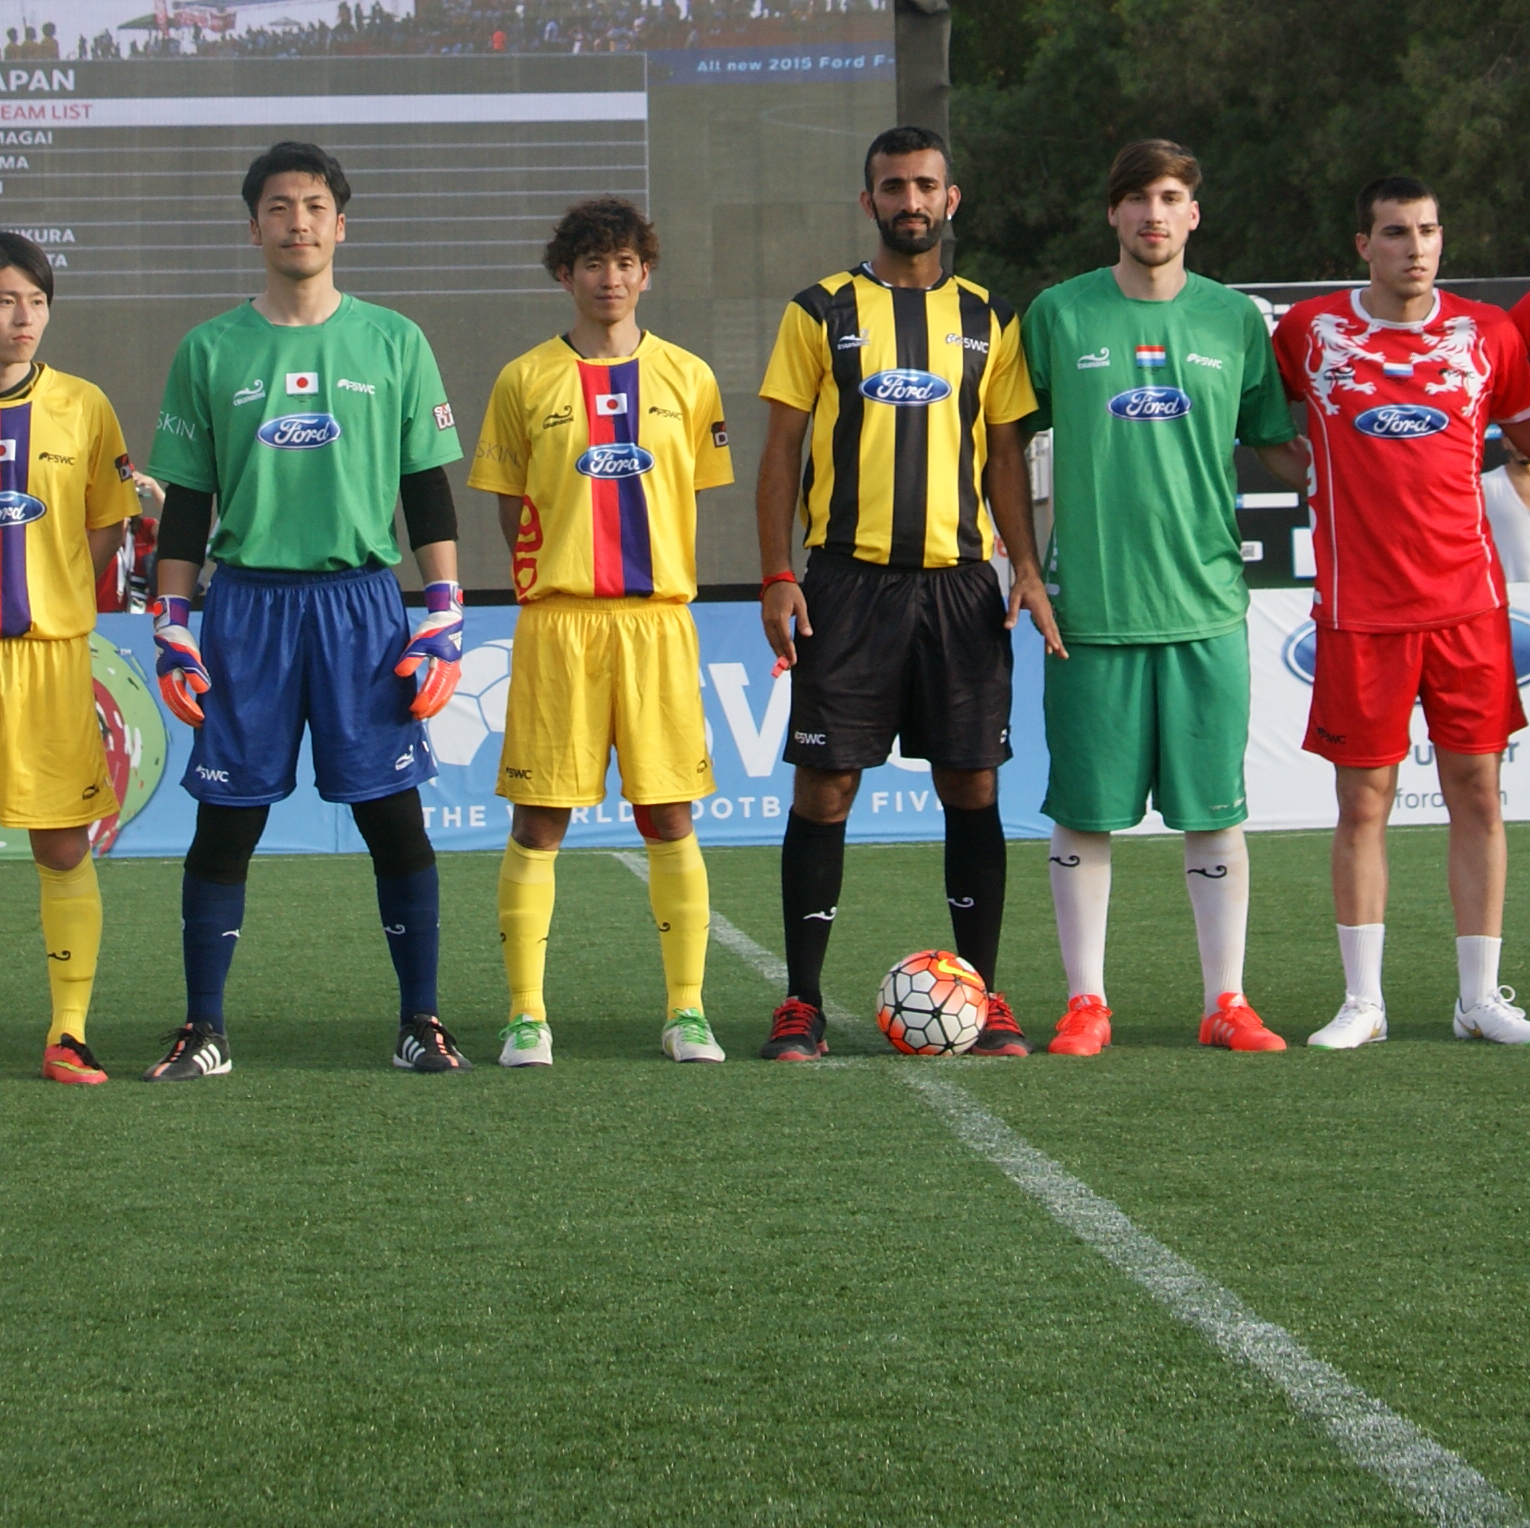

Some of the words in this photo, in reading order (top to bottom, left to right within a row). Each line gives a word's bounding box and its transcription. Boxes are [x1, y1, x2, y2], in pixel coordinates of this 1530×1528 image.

[726, 60, 762, 72] new
[769, 57, 812, 70] 2015
[819, 55, 865, 69] Ford
[52, 104, 93, 119] LIST
[877, 374, 934, 400] Ford
[1125, 391, 1181, 416] Ford
[273, 418, 329, 445] Ford
[1372, 409, 1432, 434] Ford
[422, 805, 487, 828] THE
[871, 790, 944, 814] FIV
